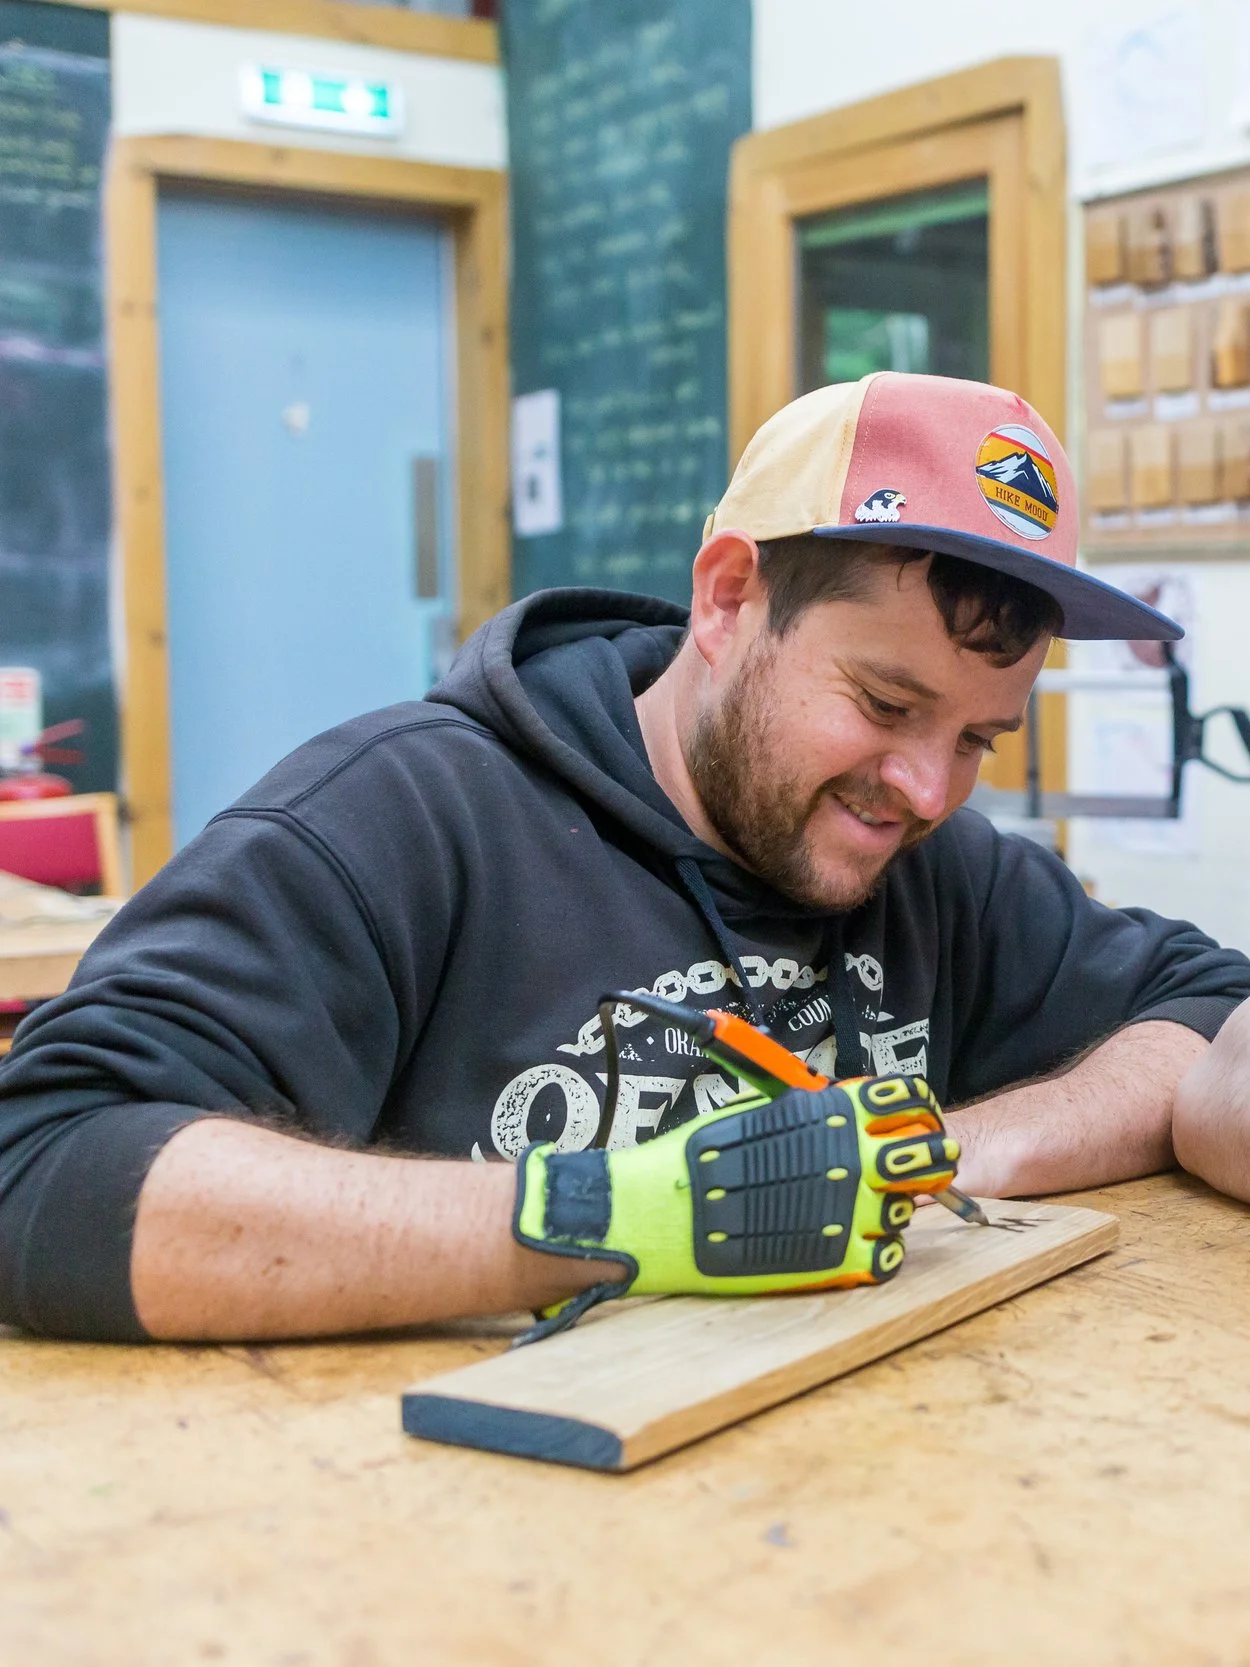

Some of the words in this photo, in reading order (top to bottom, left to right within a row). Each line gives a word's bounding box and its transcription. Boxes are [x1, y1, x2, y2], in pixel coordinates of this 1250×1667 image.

[995, 486, 1021, 507] HIKE
[1024, 499, 1048, 522] MOOD
[664, 1027, 710, 1059] ORA
[787, 997, 833, 1032] COUN
